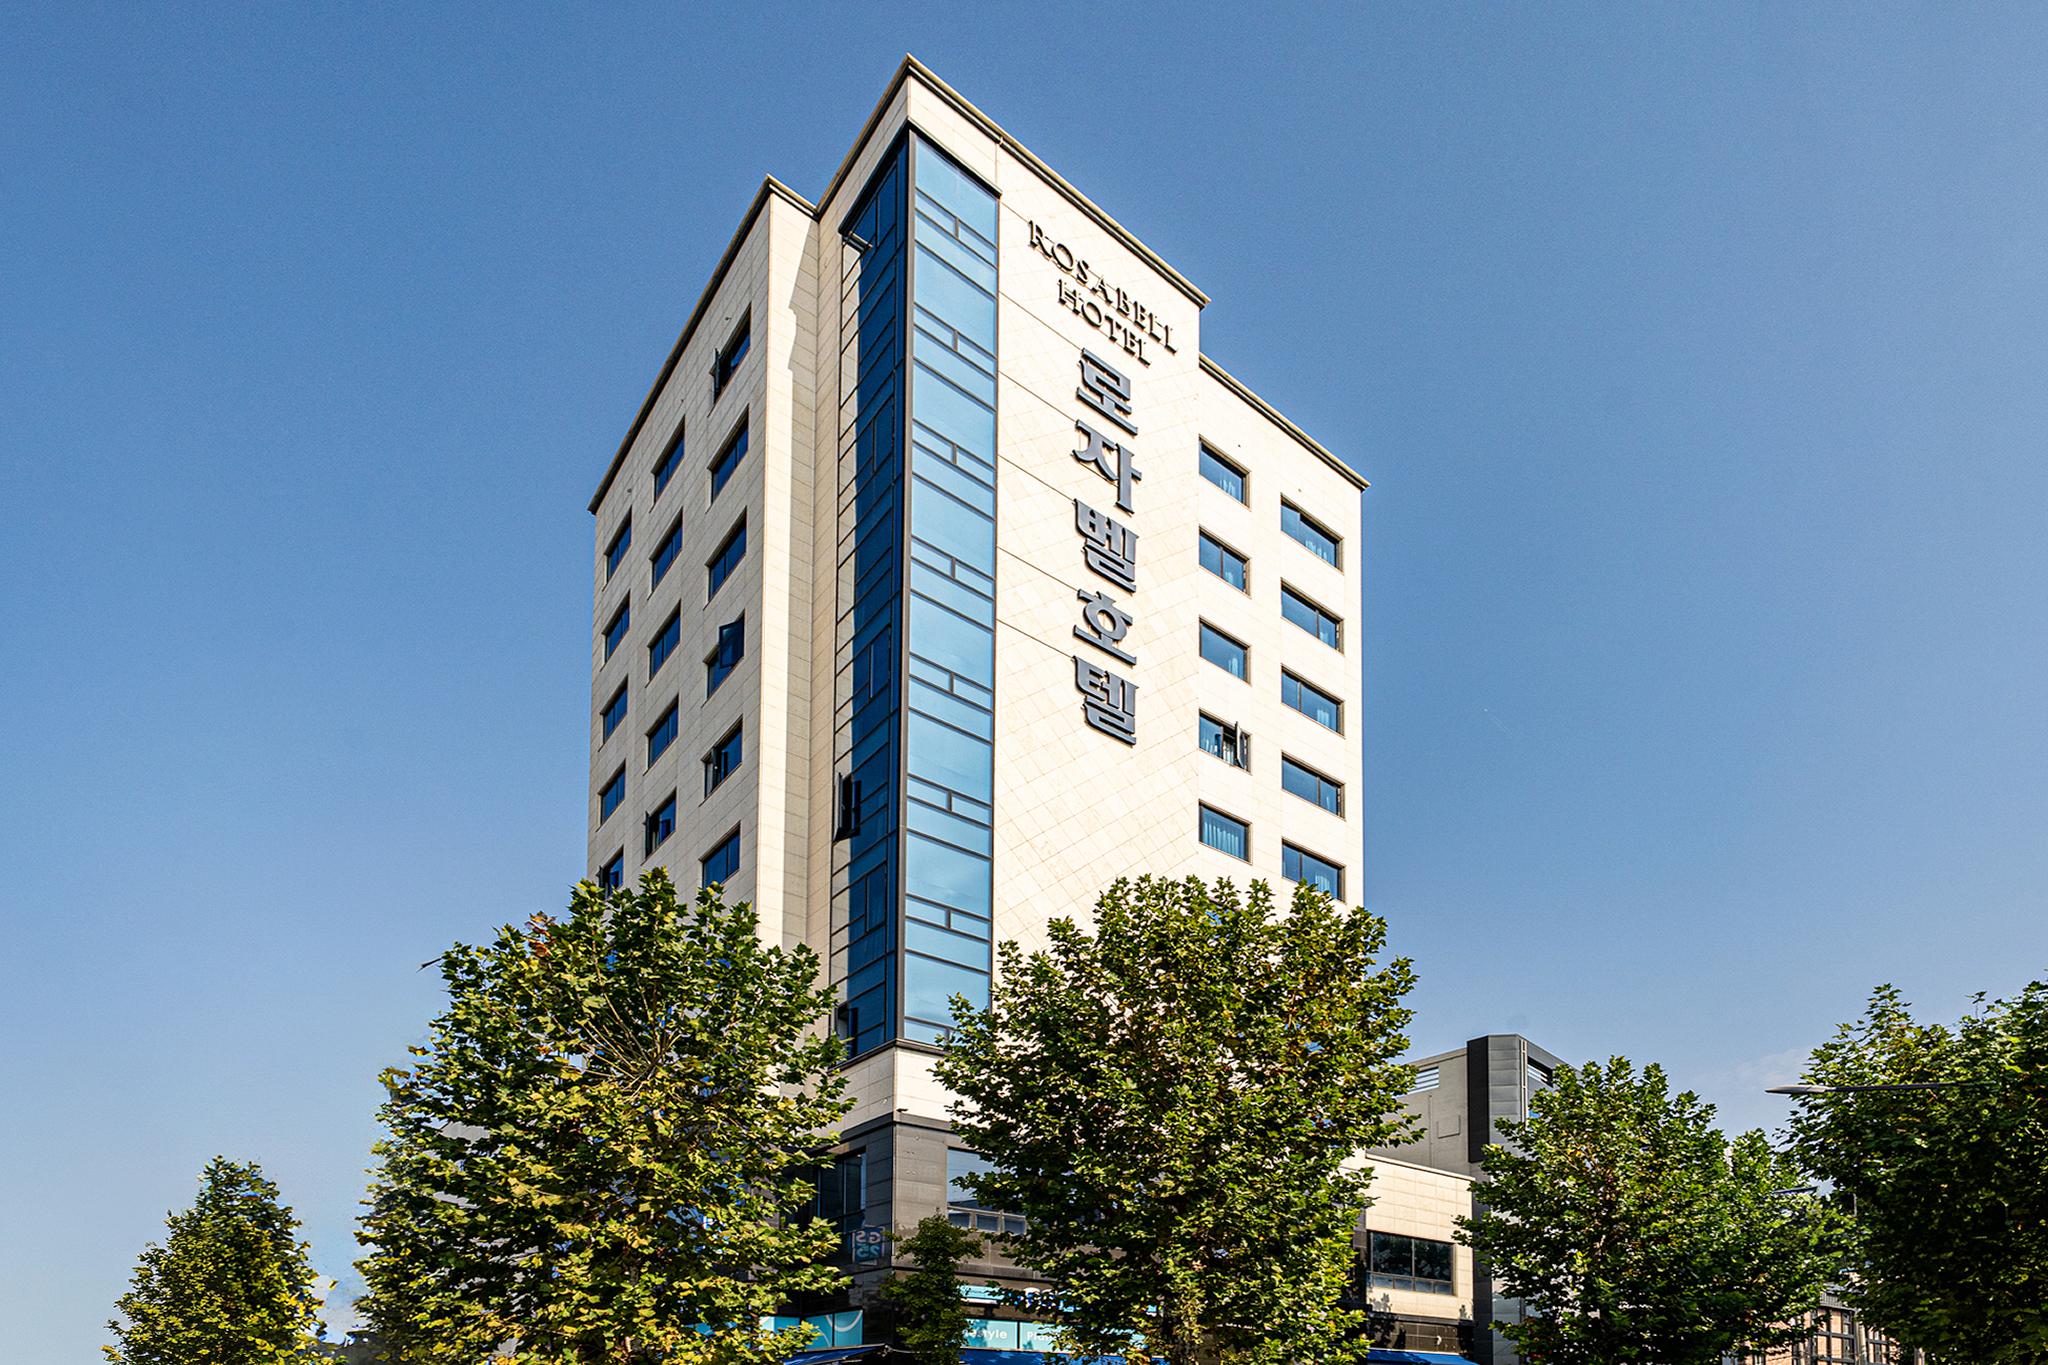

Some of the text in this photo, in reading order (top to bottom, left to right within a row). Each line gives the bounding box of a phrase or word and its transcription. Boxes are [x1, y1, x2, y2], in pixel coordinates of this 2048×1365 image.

[1028, 219, 1178, 355] ROSABELL
[1057, 278, 1151, 368] HOTEL
[1072, 347, 1142, 746] 로자벨호텔
